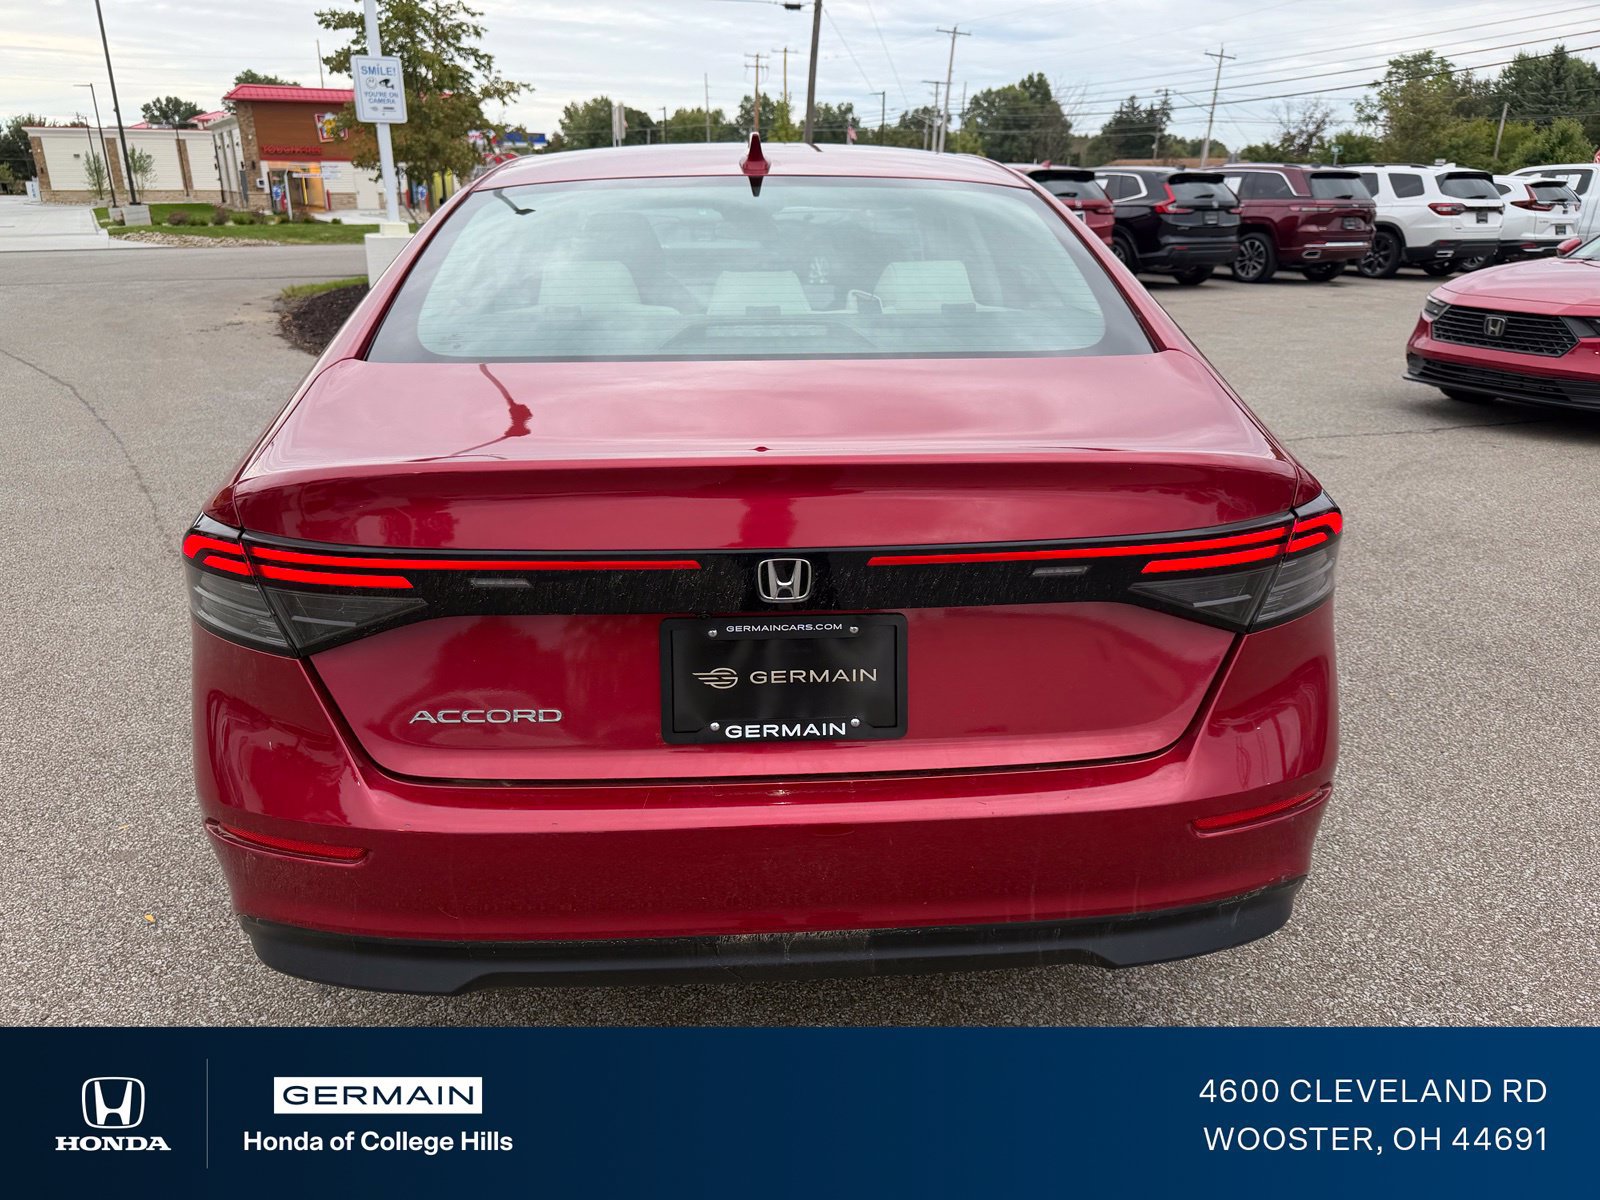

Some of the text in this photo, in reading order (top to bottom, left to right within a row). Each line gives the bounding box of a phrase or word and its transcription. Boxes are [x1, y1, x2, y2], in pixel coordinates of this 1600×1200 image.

[361, 65, 396, 76] SMILE!
[368, 97, 396, 105] CAMERA
[726, 623, 843, 633] GERMAINCARS.COM
[750, 668, 877, 685] GERMAIN
[408, 708, 563, 724] ACCORD
[724, 722, 846, 739] GERMAIN
